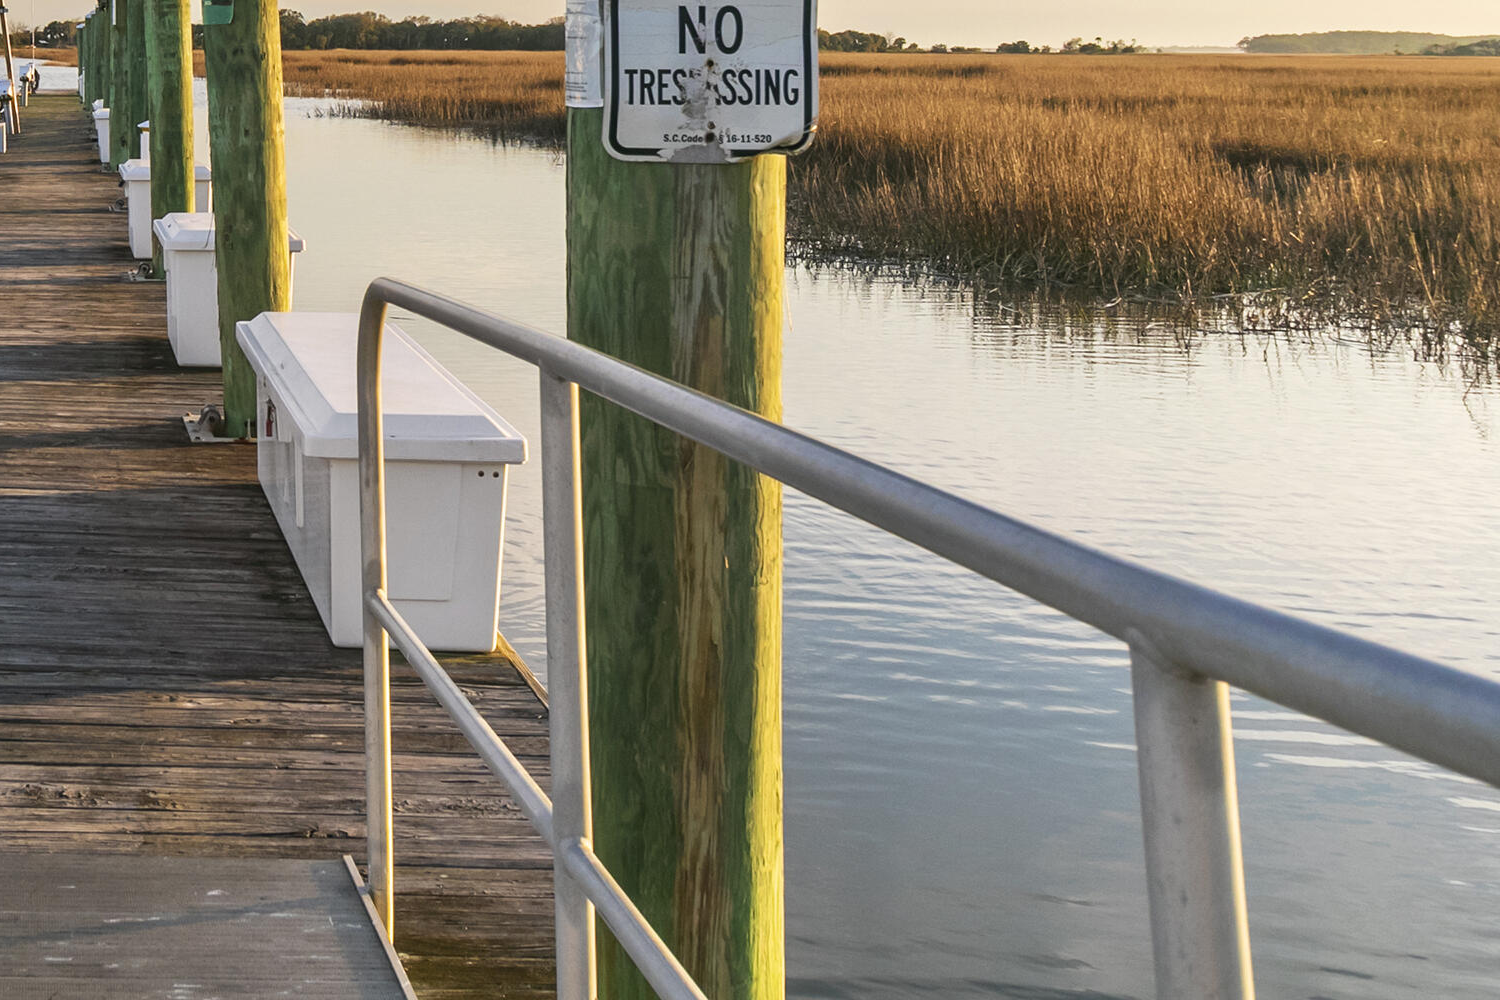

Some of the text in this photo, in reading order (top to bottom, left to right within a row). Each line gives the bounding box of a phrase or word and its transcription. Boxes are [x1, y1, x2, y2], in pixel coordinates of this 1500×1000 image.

[678, 5, 744, 55] NO
[625, 69, 799, 105] TRESSSING
[727, 134, 772, 143] 16-11-520
